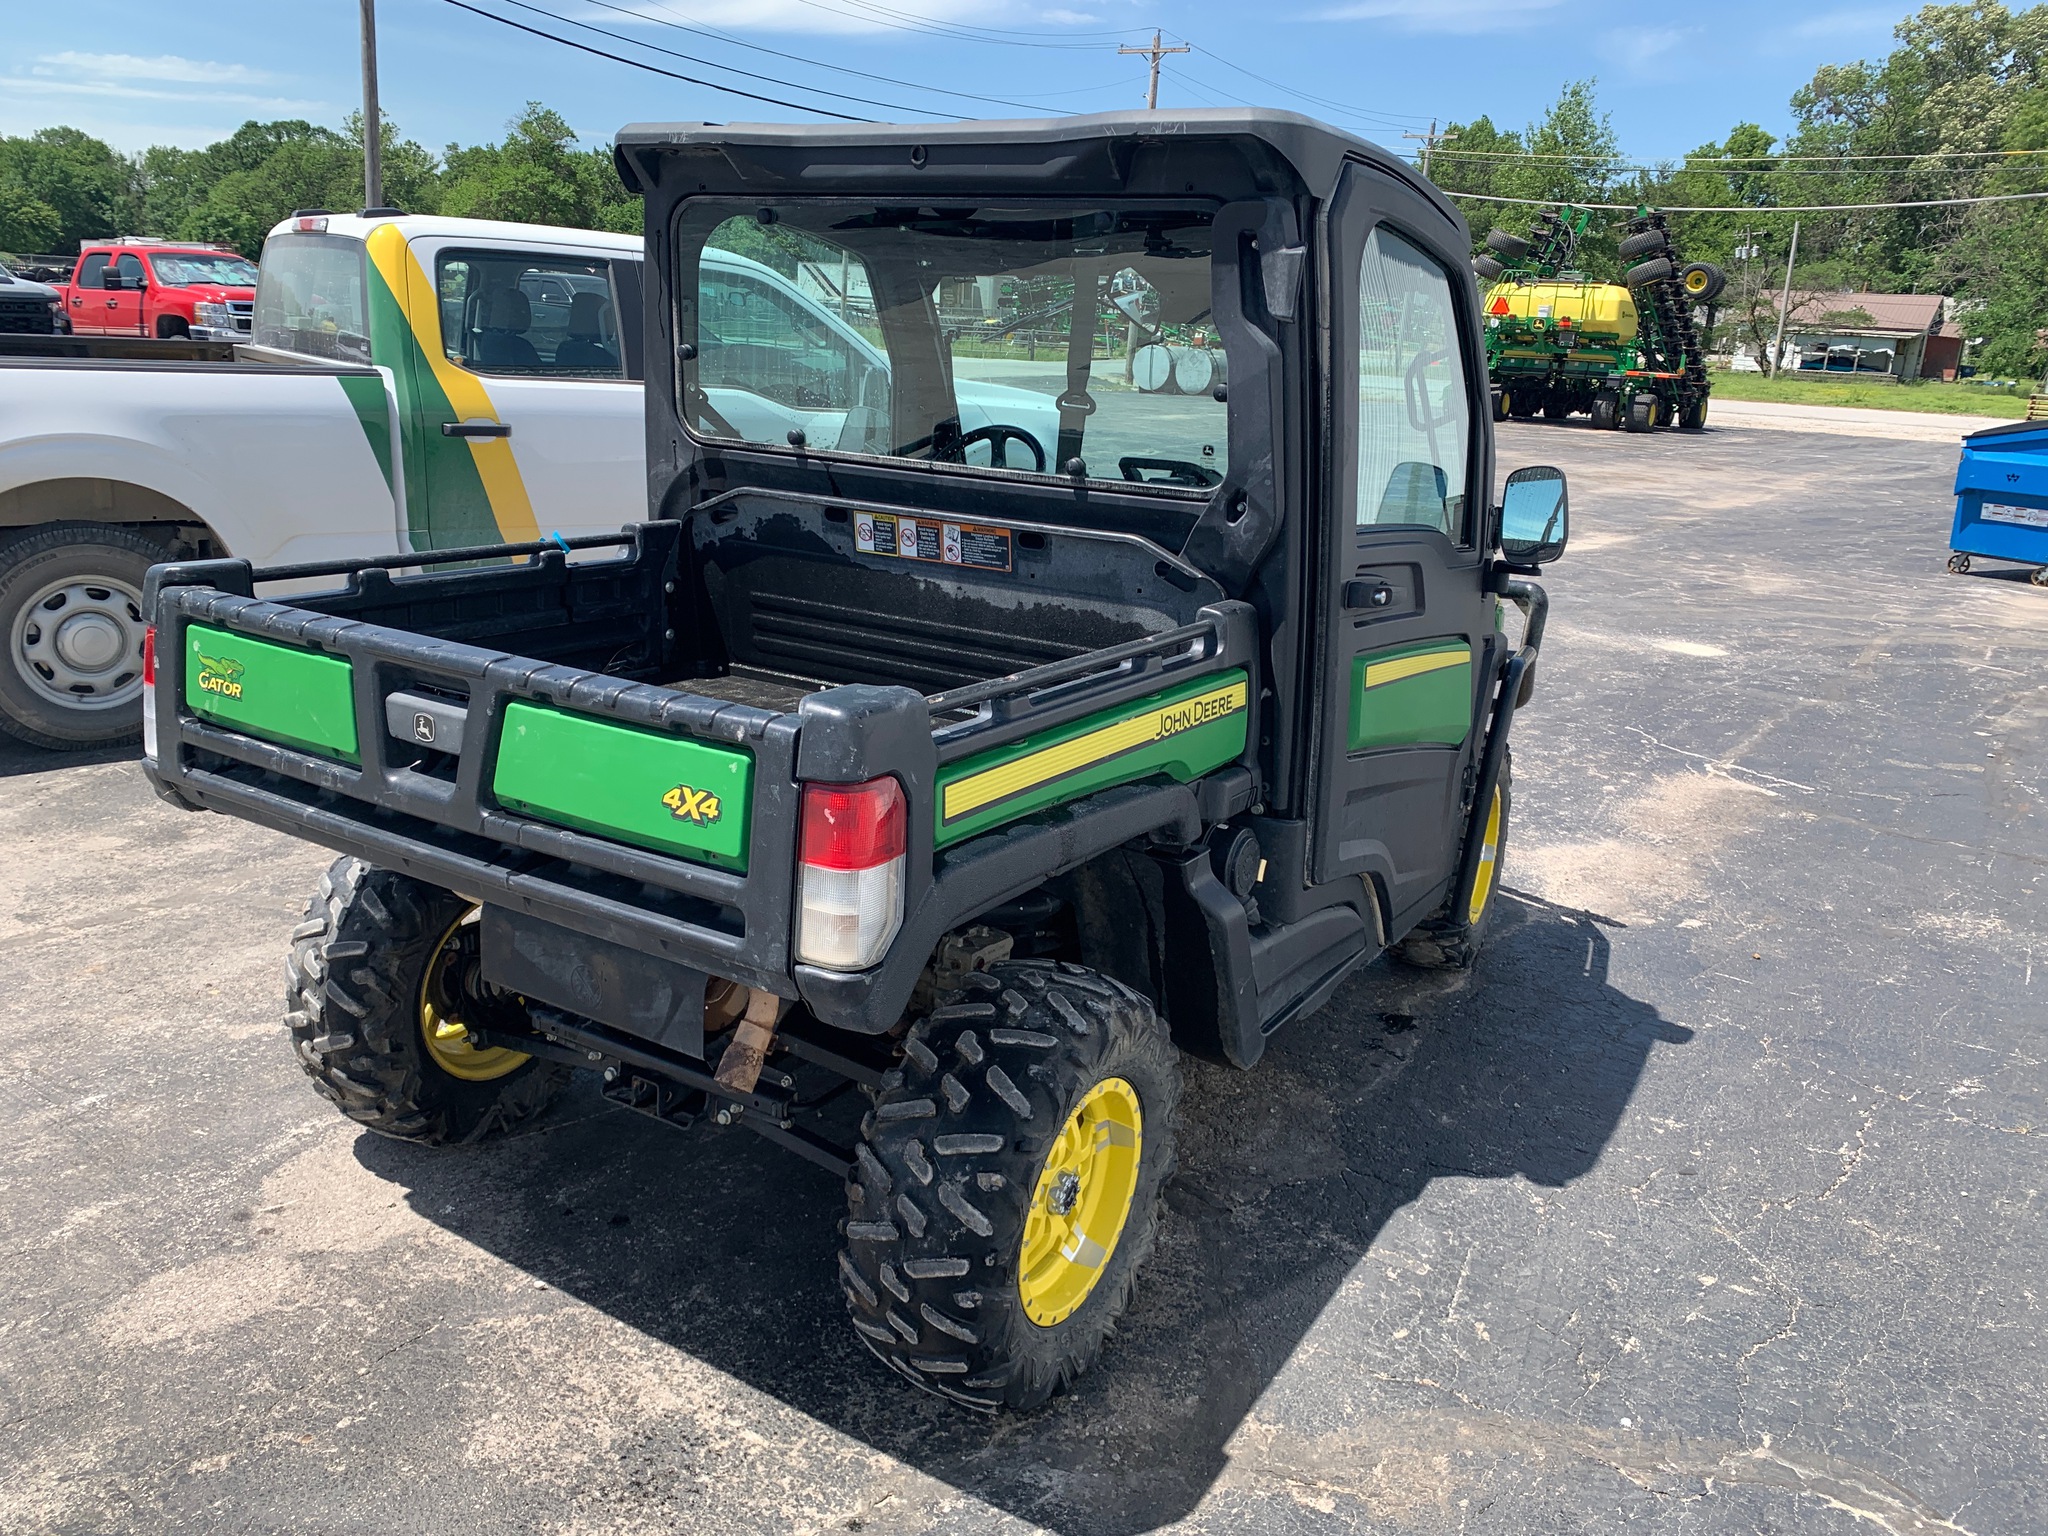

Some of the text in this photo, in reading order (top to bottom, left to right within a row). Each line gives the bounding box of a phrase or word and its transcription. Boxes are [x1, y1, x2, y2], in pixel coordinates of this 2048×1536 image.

[198, 671, 242, 698] GATOR
[1156, 694, 1233, 736] JOHN DEERE
[662, 785, 720, 823] 4X4
